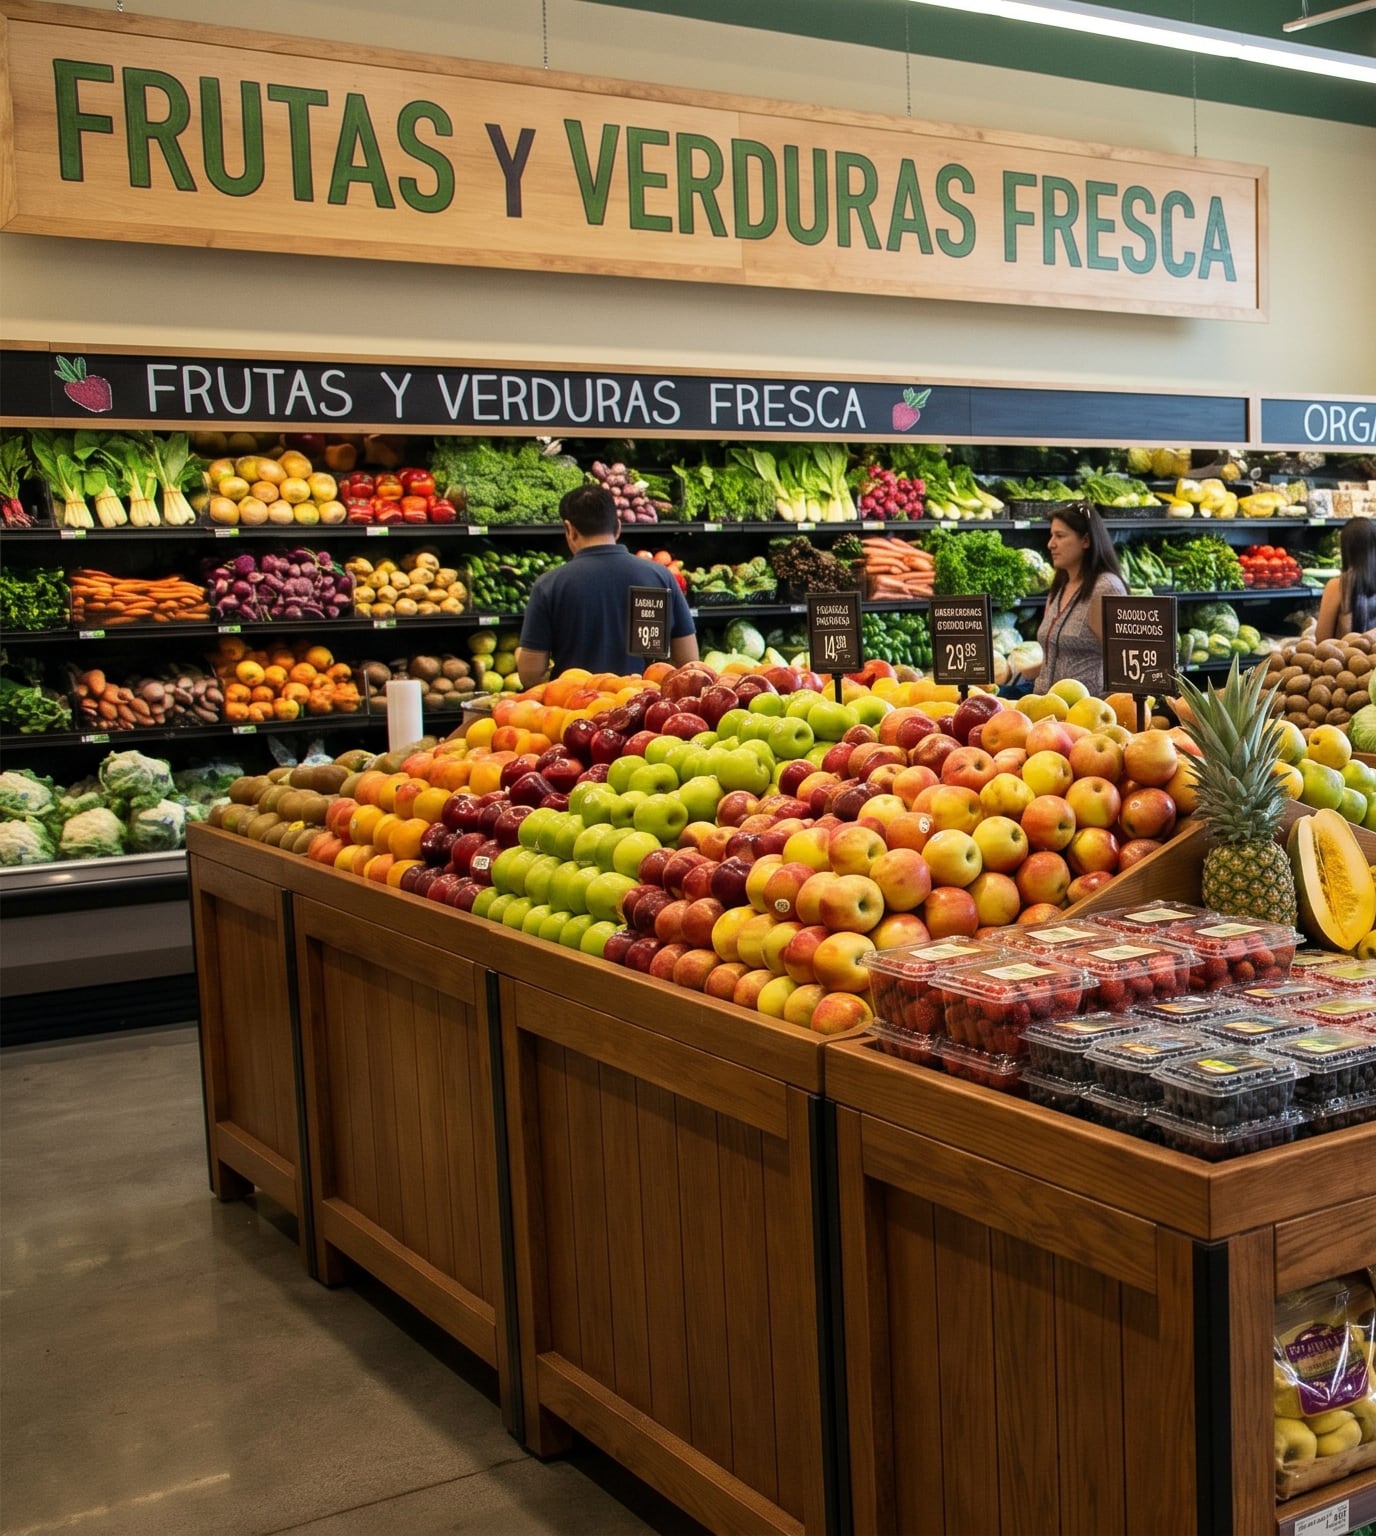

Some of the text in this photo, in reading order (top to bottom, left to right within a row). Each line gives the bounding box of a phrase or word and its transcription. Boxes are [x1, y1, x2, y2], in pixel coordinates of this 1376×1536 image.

[53, 58, 1238, 284] FRUTAS Y VERDURAS FRESCA
[147, 362, 867, 431] FRUTAS Y VERDURAS FRESCA
